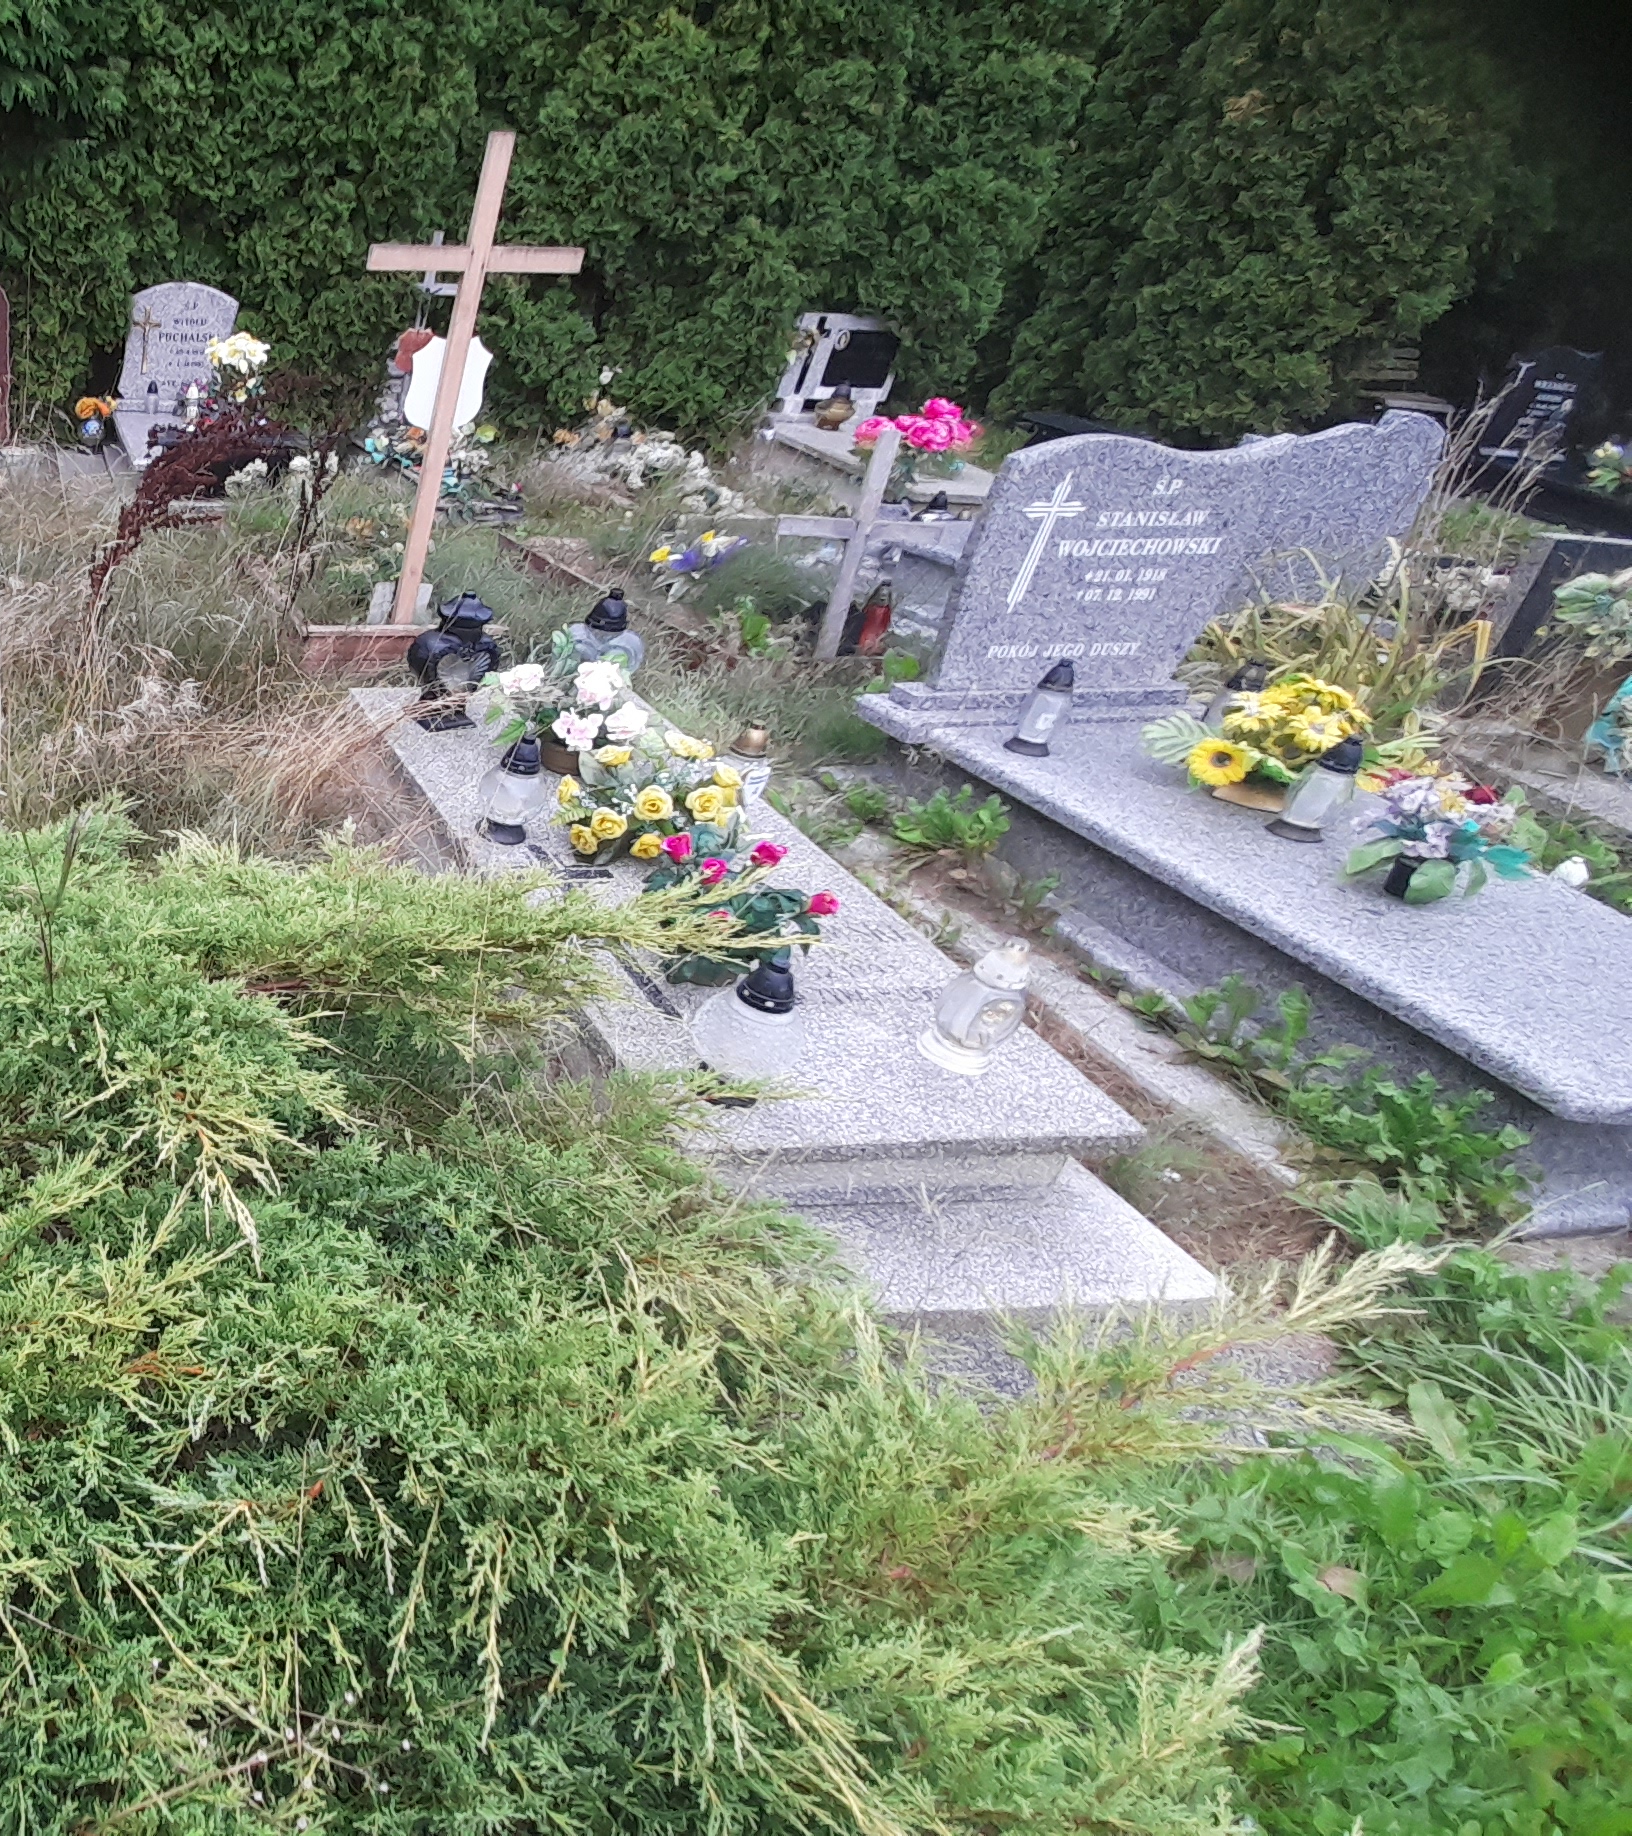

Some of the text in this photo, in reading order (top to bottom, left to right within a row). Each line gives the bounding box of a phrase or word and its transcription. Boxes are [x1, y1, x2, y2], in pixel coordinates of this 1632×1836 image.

[1096, 510, 1210, 527] STANISŁAW
[1058, 537, 1222, 558] WOJCIECHOWSKI
[986, 640, 1141, 659] POKÓJ JEGO DUSZY
